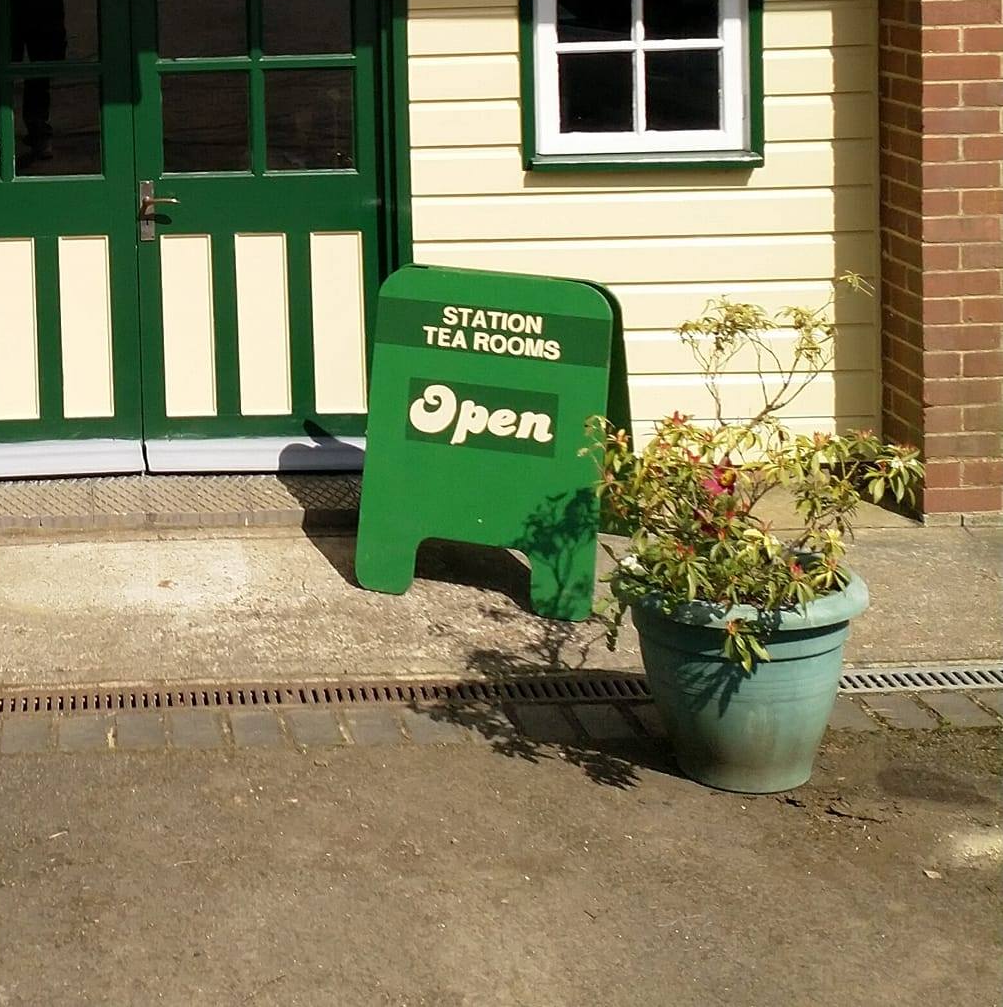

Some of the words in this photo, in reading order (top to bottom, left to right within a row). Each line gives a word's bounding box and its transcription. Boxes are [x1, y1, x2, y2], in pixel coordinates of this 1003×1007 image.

[443, 306, 543, 334] STATION
[423, 326, 468, 349] TEA
[474, 331, 561, 360] ROOMS
[409, 384, 553, 445] Open
